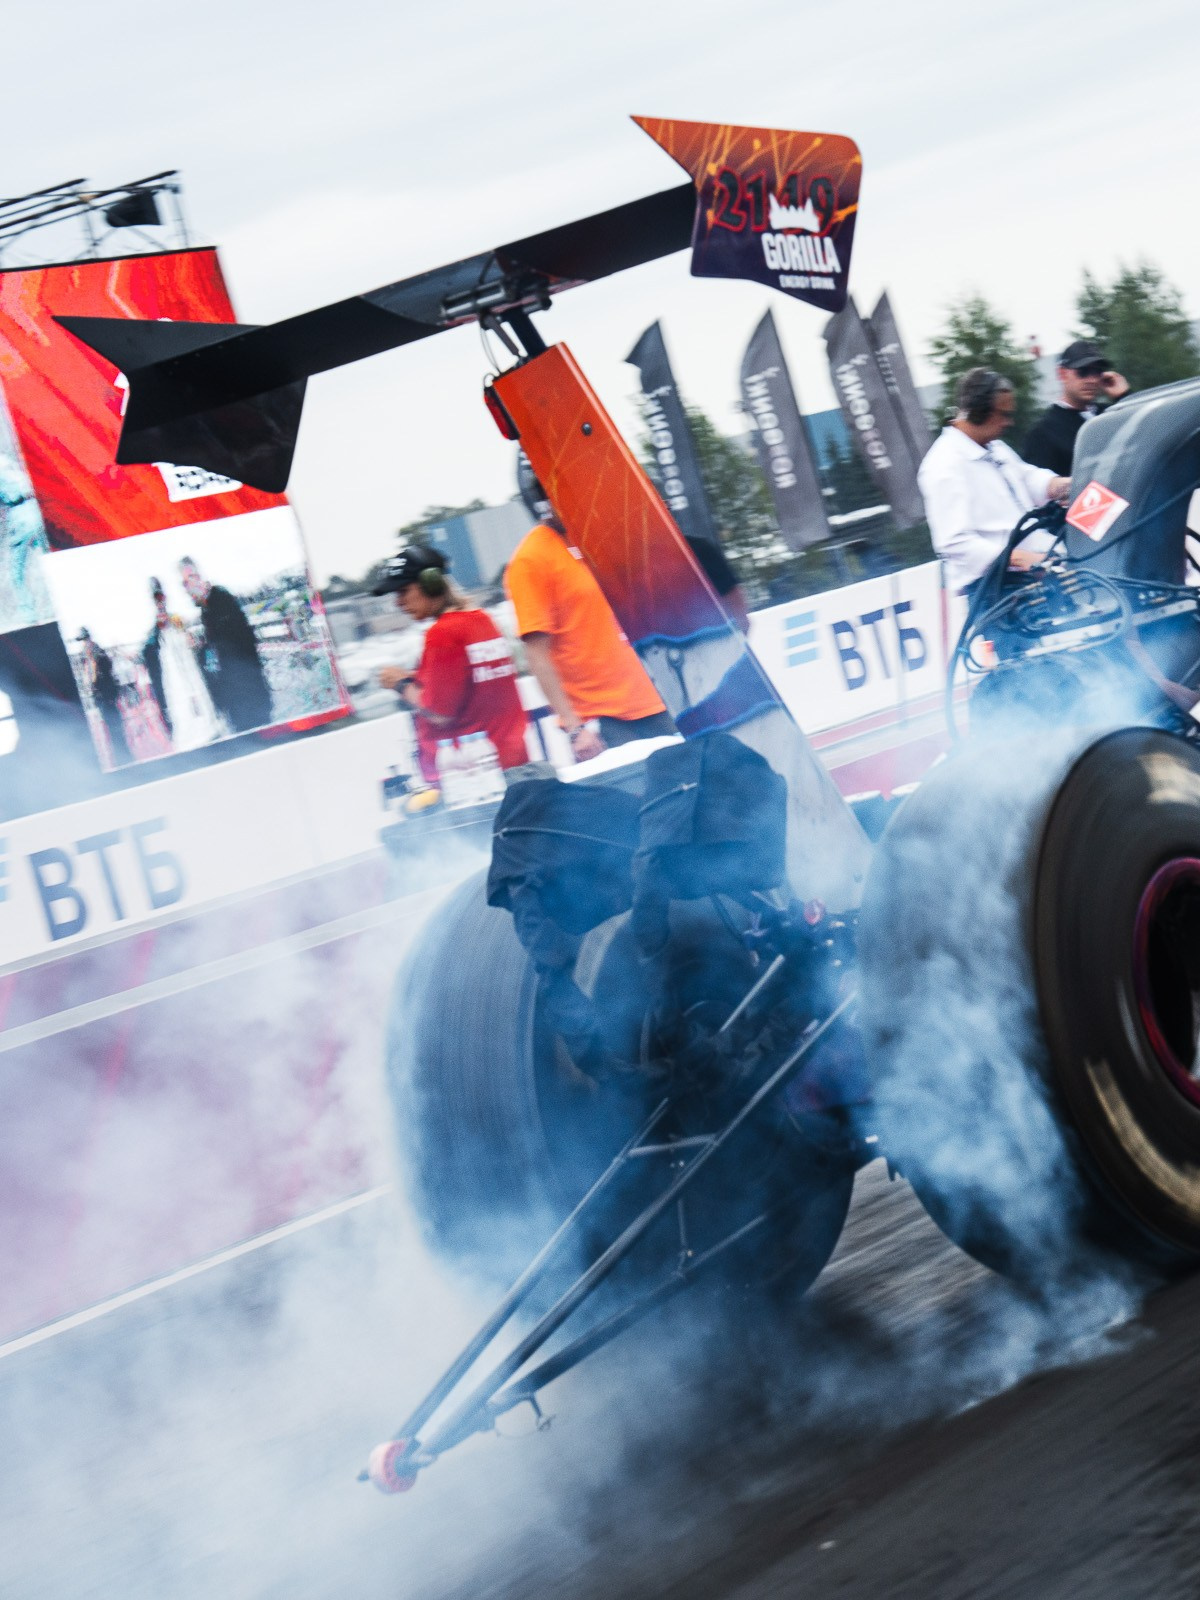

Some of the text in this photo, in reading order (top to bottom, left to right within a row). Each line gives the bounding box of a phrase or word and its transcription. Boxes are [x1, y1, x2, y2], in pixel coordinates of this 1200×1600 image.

[761, 233, 841, 273] GORILLA
[832, 600, 927, 691] ВТБ
[28, 815, 187, 941] ВТБ
